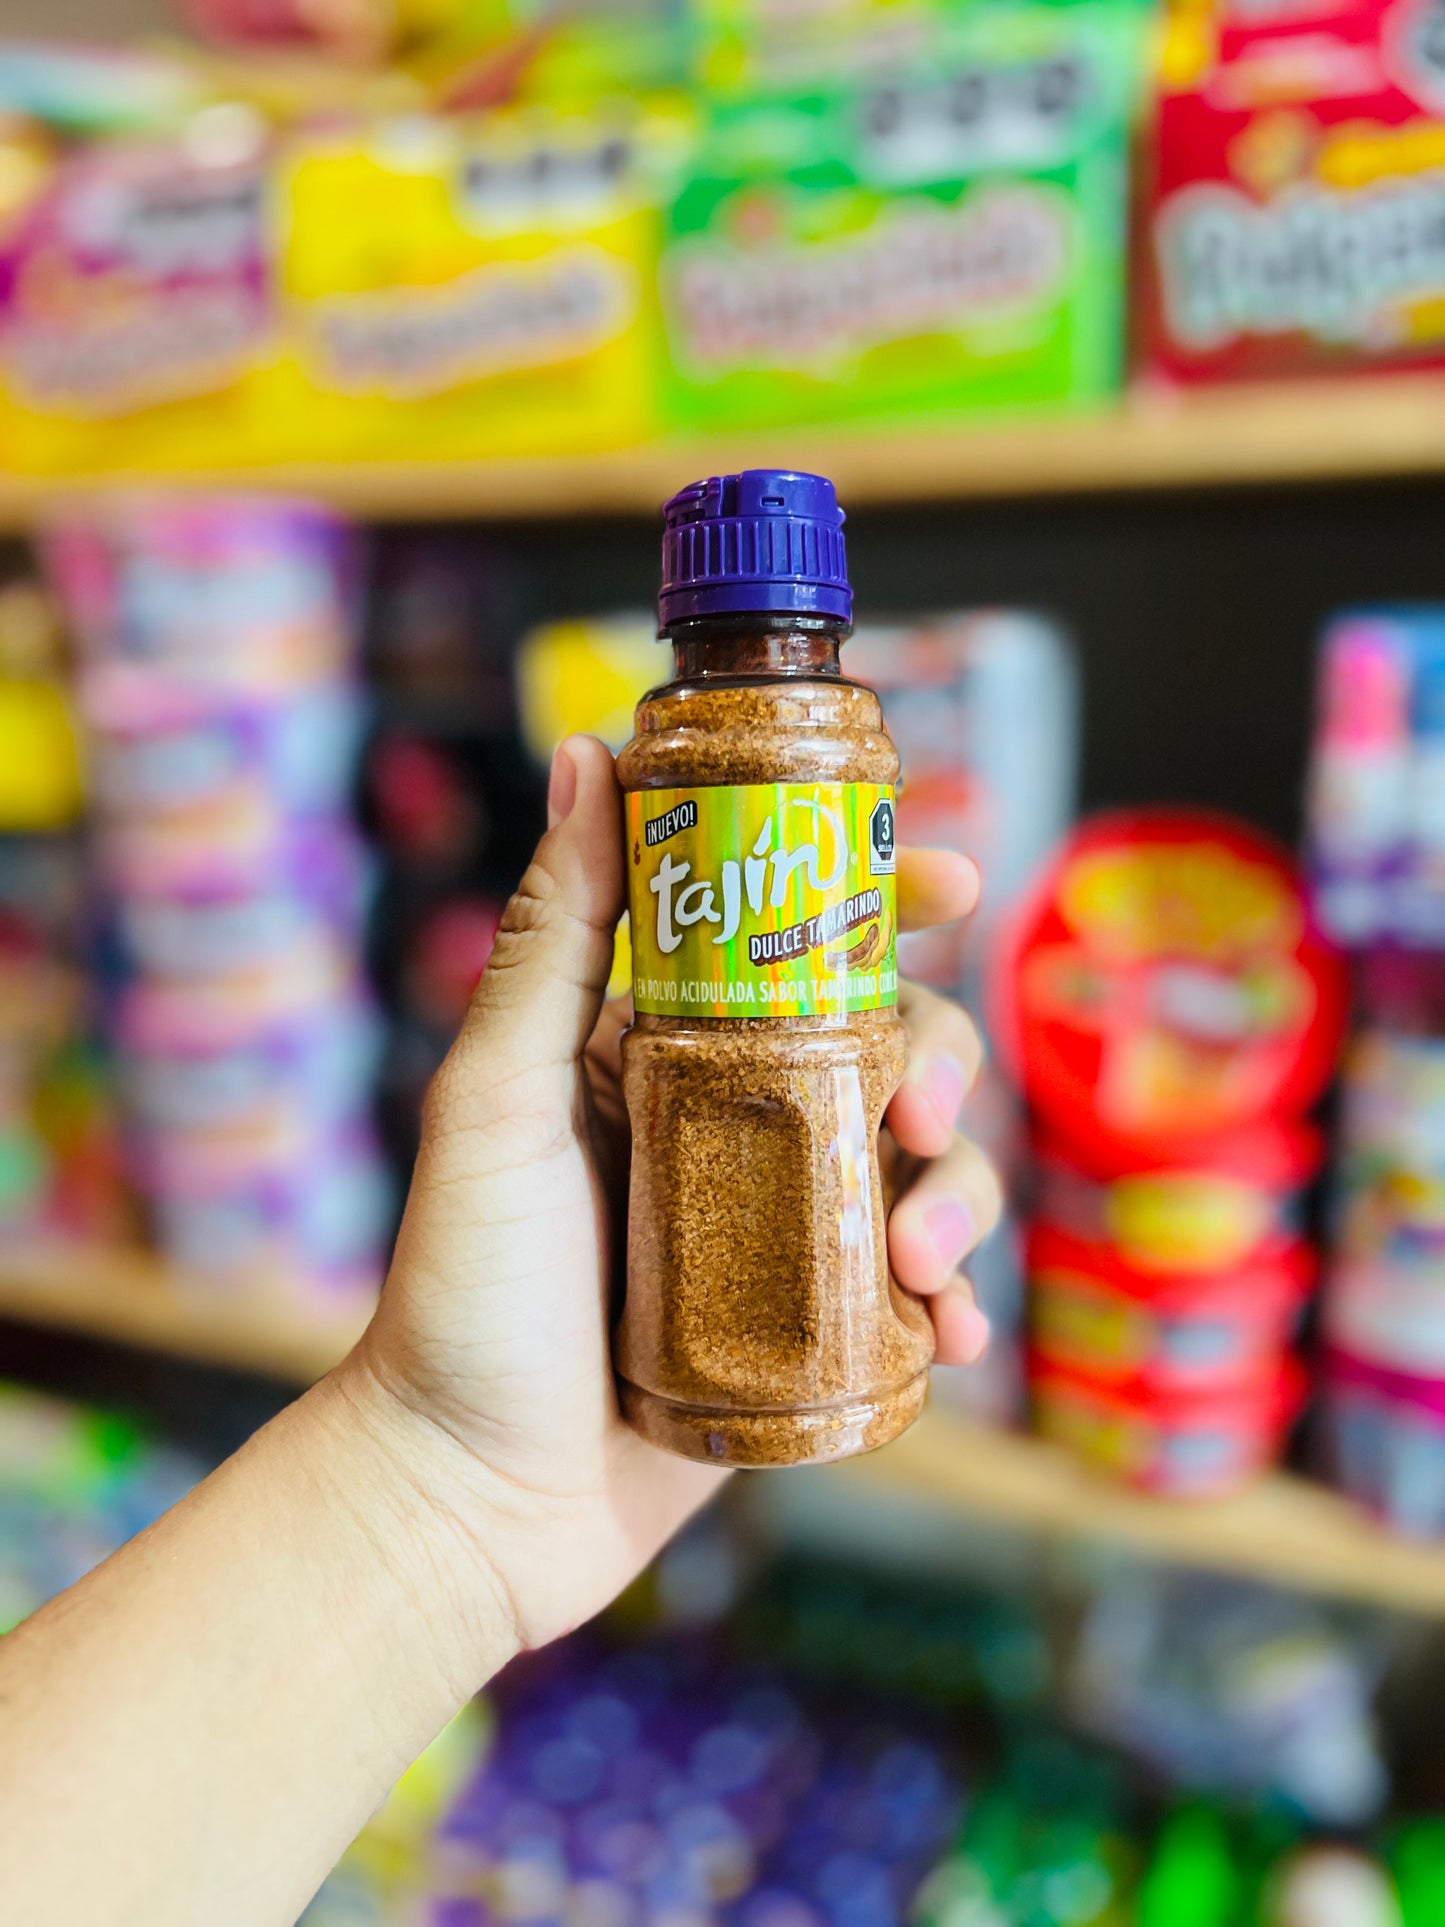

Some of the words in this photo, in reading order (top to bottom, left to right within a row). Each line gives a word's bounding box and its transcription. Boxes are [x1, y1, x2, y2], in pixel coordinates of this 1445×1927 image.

[646, 803, 694, 845] ¡NUEVO!
[881, 813, 890, 841] 3
[650, 798, 848, 953] tajín
[751, 925, 803, 961] DULCE
[807, 890, 880, 942] TAMARINDO
[648, 979, 677, 1002] POLVO
[681, 981, 755, 1003] ACIDULADA
[759, 979, 806, 1003] SABOR
